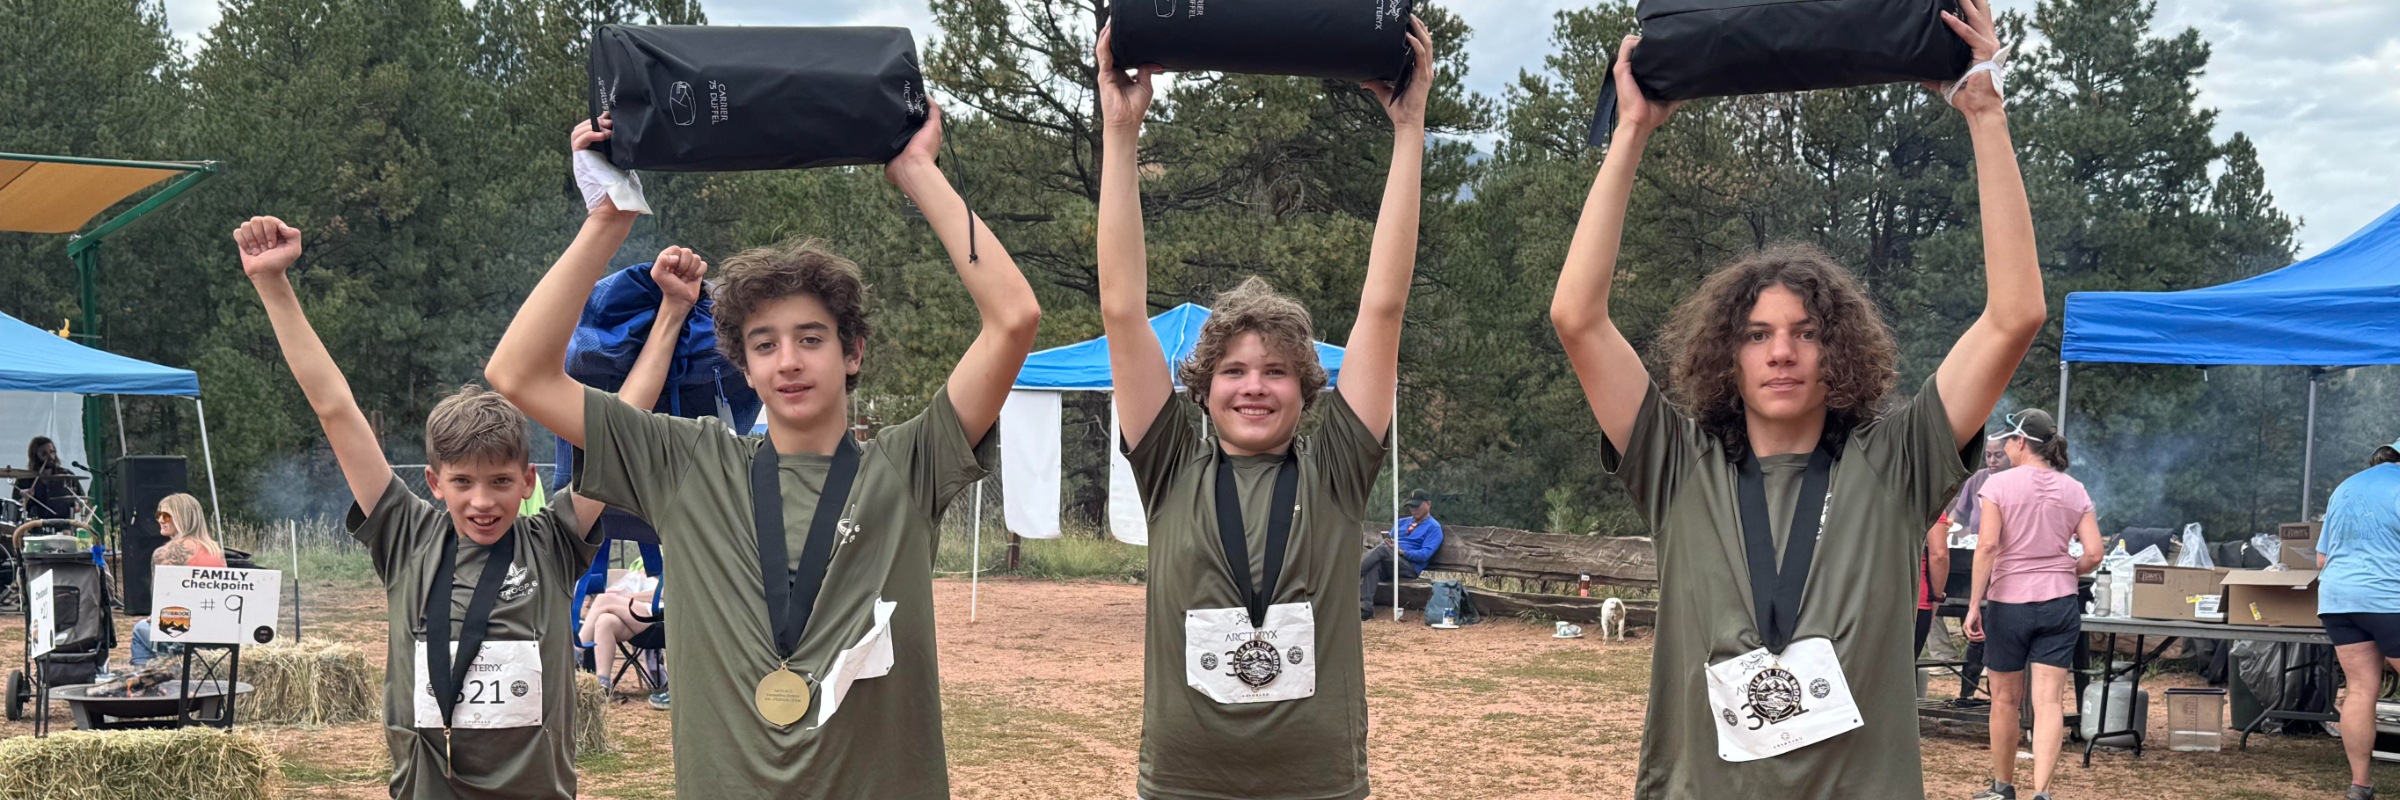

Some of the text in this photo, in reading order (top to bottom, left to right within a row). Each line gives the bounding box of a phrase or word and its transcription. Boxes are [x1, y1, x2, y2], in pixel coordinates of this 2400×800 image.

[709, 80, 719, 125] 75 DUFFEL
[718, 84, 728, 121] CARRIER
[192, 569, 249, 581] FAMILY
[182, 579, 255, 591] Checkpoint
[500, 583, 530, 598] TROOP
[224, 594, 243, 624] 9
[1257, 641, 1271, 651] THE
[1761, 669, 1772, 680] BY
[1774, 669, 1790, 680] THE
